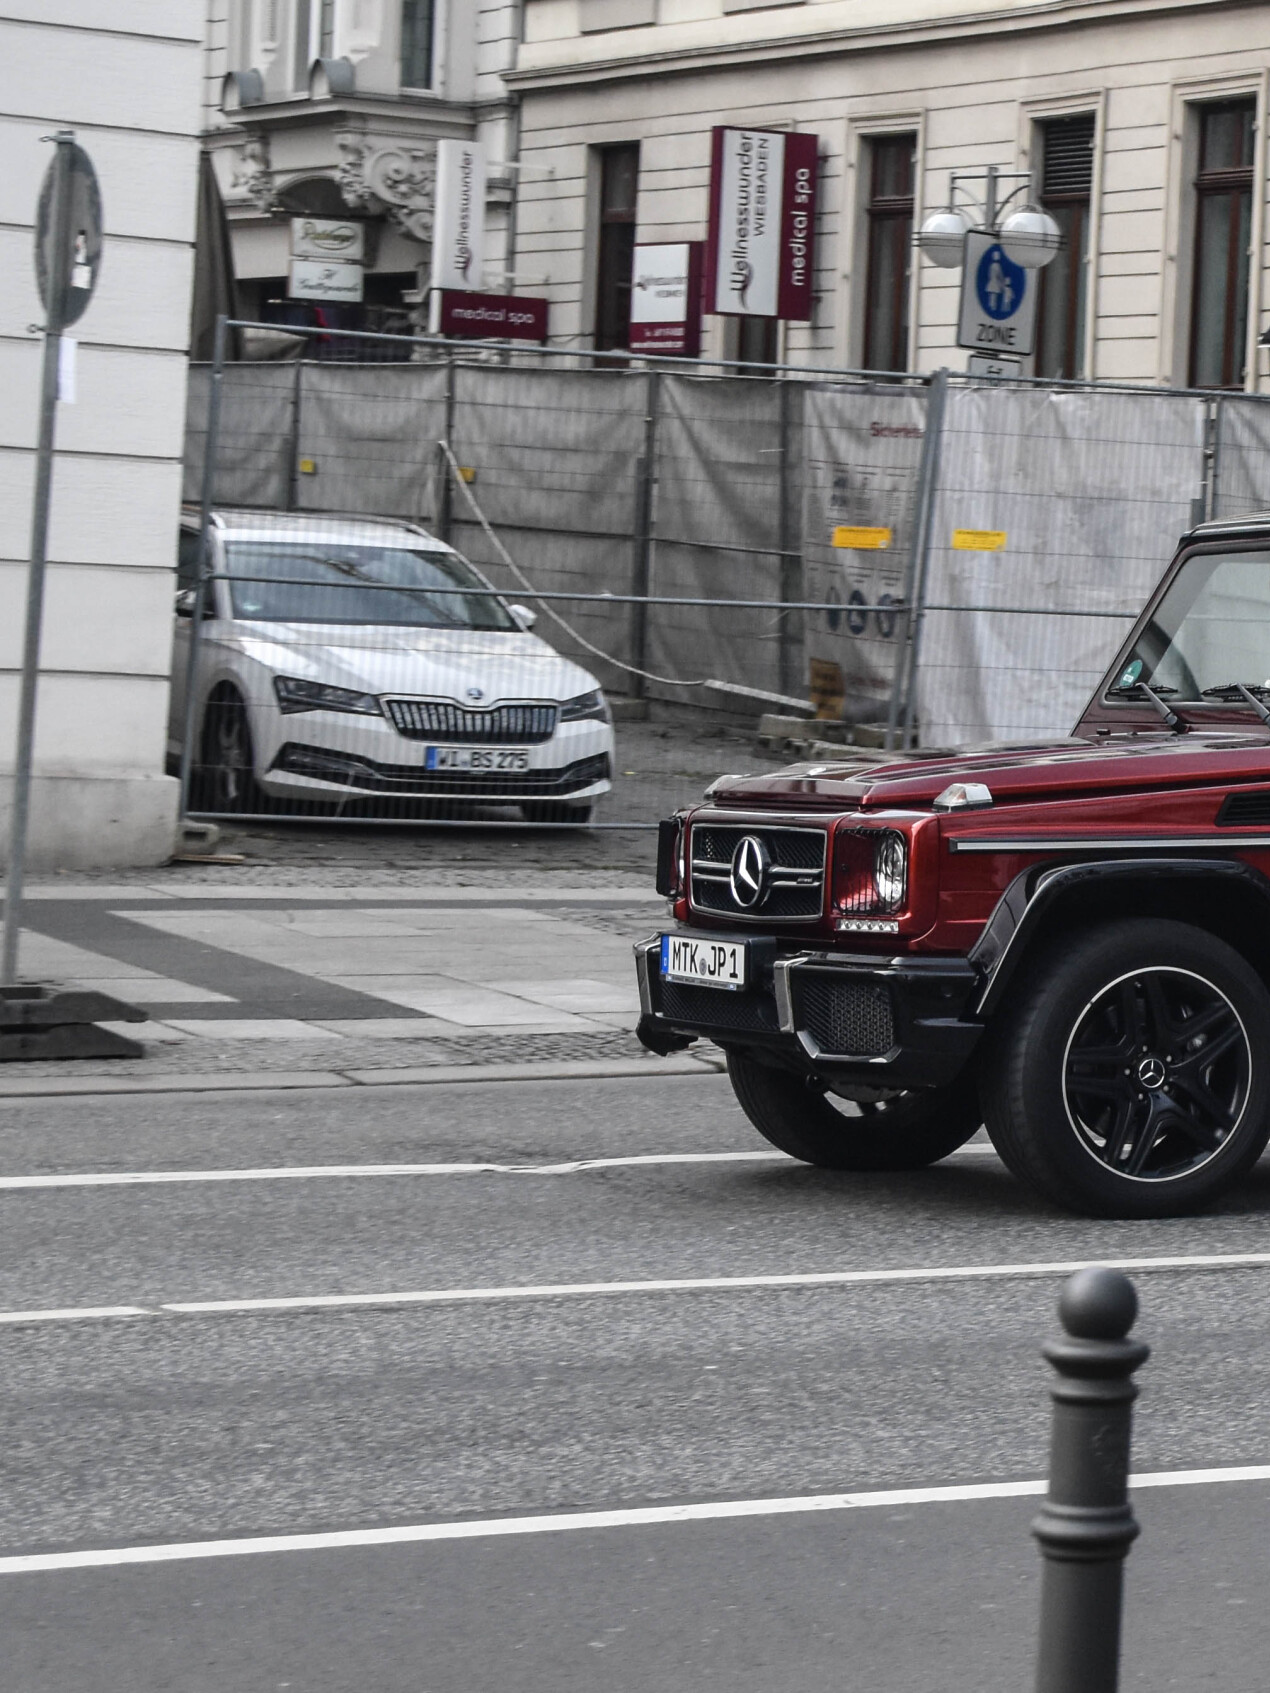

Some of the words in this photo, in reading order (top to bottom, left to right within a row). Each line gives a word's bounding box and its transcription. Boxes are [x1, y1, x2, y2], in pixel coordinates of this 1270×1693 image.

[454, 152, 473, 271] Wellnesswunder
[729, 133, 753, 292] Wellnesswunder
[753, 137, 769, 237] WIESBADEN
[794, 168, 813, 204] spa
[788, 210, 809, 286] medical
[452, 307, 506, 321] medical
[508, 310, 535, 325] spa
[976, 323, 1017, 346] ZONE
[673, 941, 699, 974] MTK
